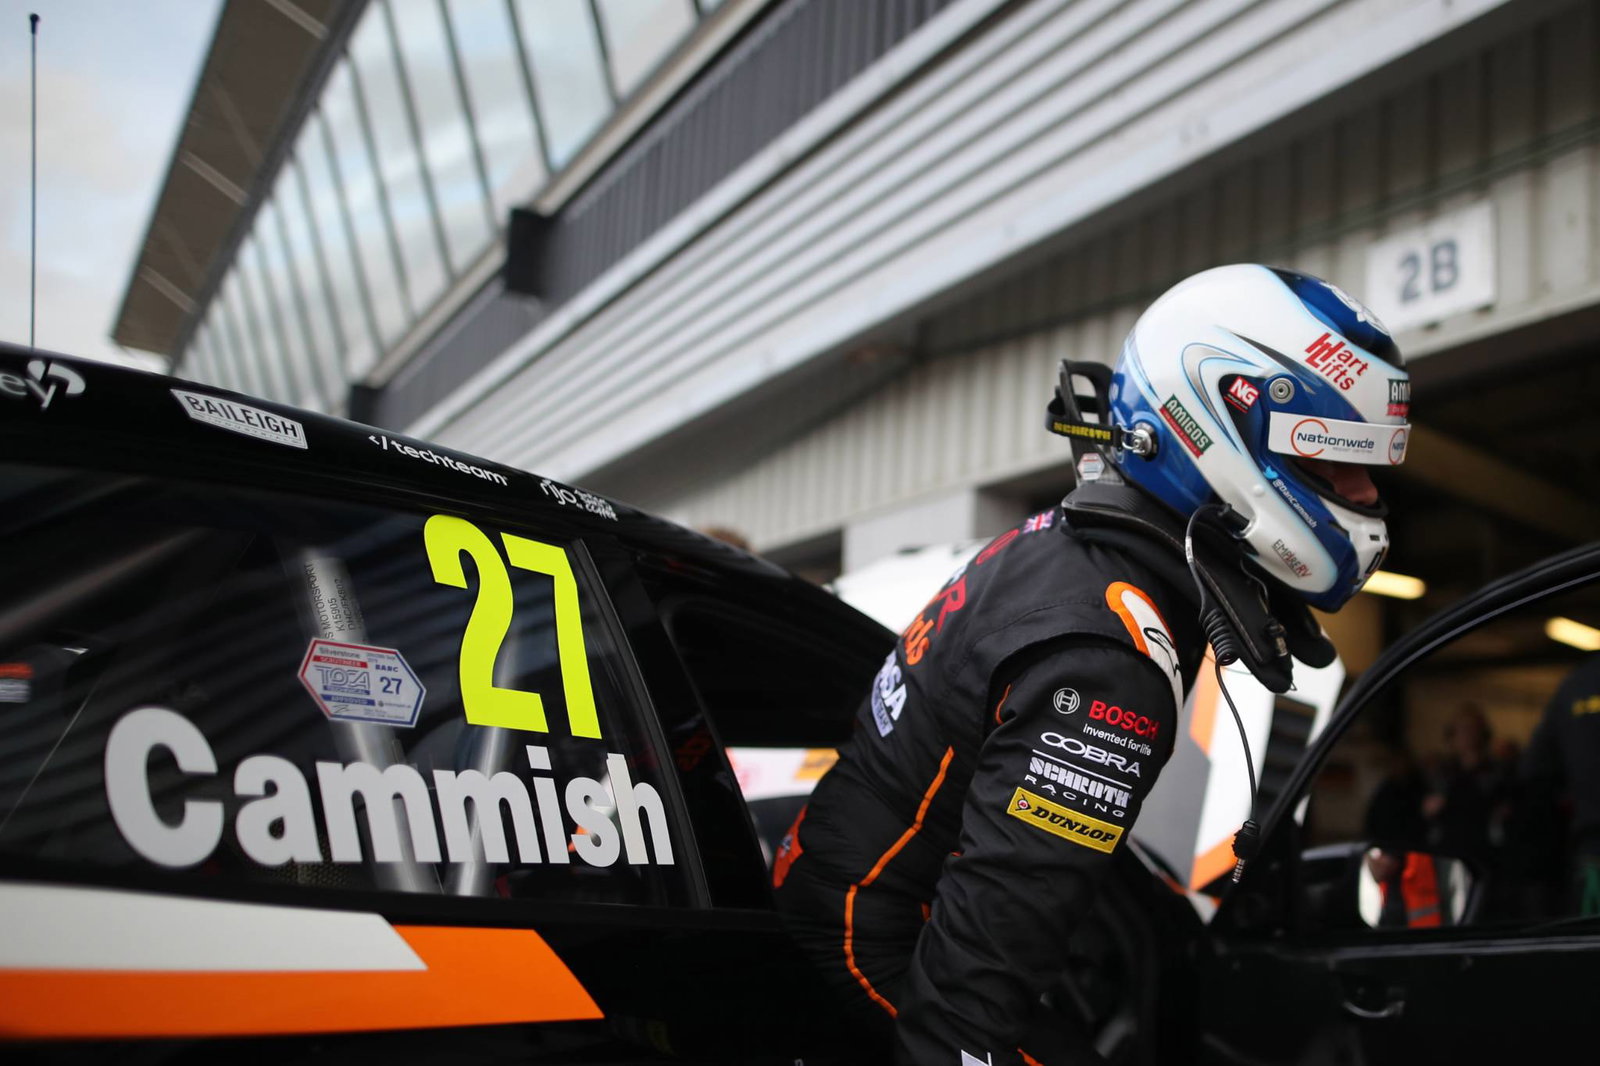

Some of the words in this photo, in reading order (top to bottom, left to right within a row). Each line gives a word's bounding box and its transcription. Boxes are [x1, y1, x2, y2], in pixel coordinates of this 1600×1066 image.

[1399, 238, 1458, 304] 2B
[1231, 378, 1258, 406] NG
[185, 395, 298, 438] BAILEIGH
[1166, 398, 1208, 449] AMIGOS
[1297, 432, 1375, 450] Nationwide
[424, 514, 602, 740] 27
[375, 664, 398, 673] BARC
[380, 676, 402, 695] 27
[1088, 700, 1160, 740] BOSCH
[1040, 732, 1141, 778] COBRA
[1128, 740, 1141, 753] for
[1140, 743, 1152, 756] life
[105, 706, 674, 868] Cammish
[1025, 775, 1125, 818] RACING
[1029, 757, 1131, 808] SCHROTH
[1031, 806, 1116, 843] DUNLOP
